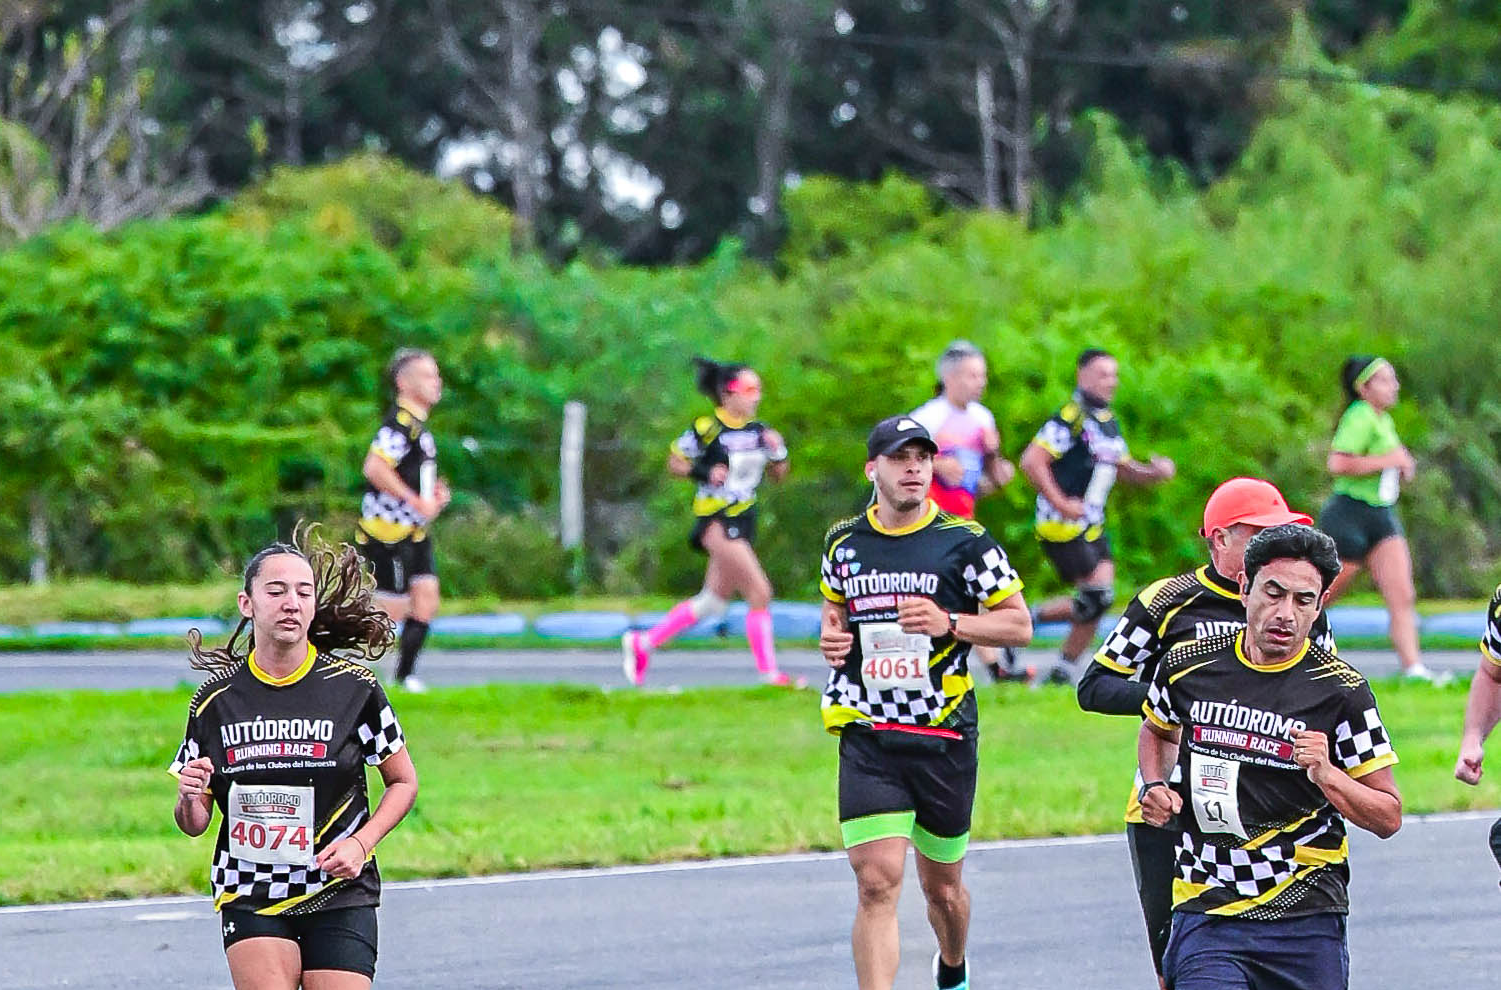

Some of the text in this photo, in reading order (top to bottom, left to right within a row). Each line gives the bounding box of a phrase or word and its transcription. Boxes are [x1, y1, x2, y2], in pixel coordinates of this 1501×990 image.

[864, 656, 924, 680] 4061
[220, 715, 334, 748] AUTÓDROMO
[1200, 728, 1248, 748] RUNNING
[1249, 736, 1282, 756] RACE
[234, 743, 315, 762] RUNNING RACE
[230, 821, 309, 851] 4074
